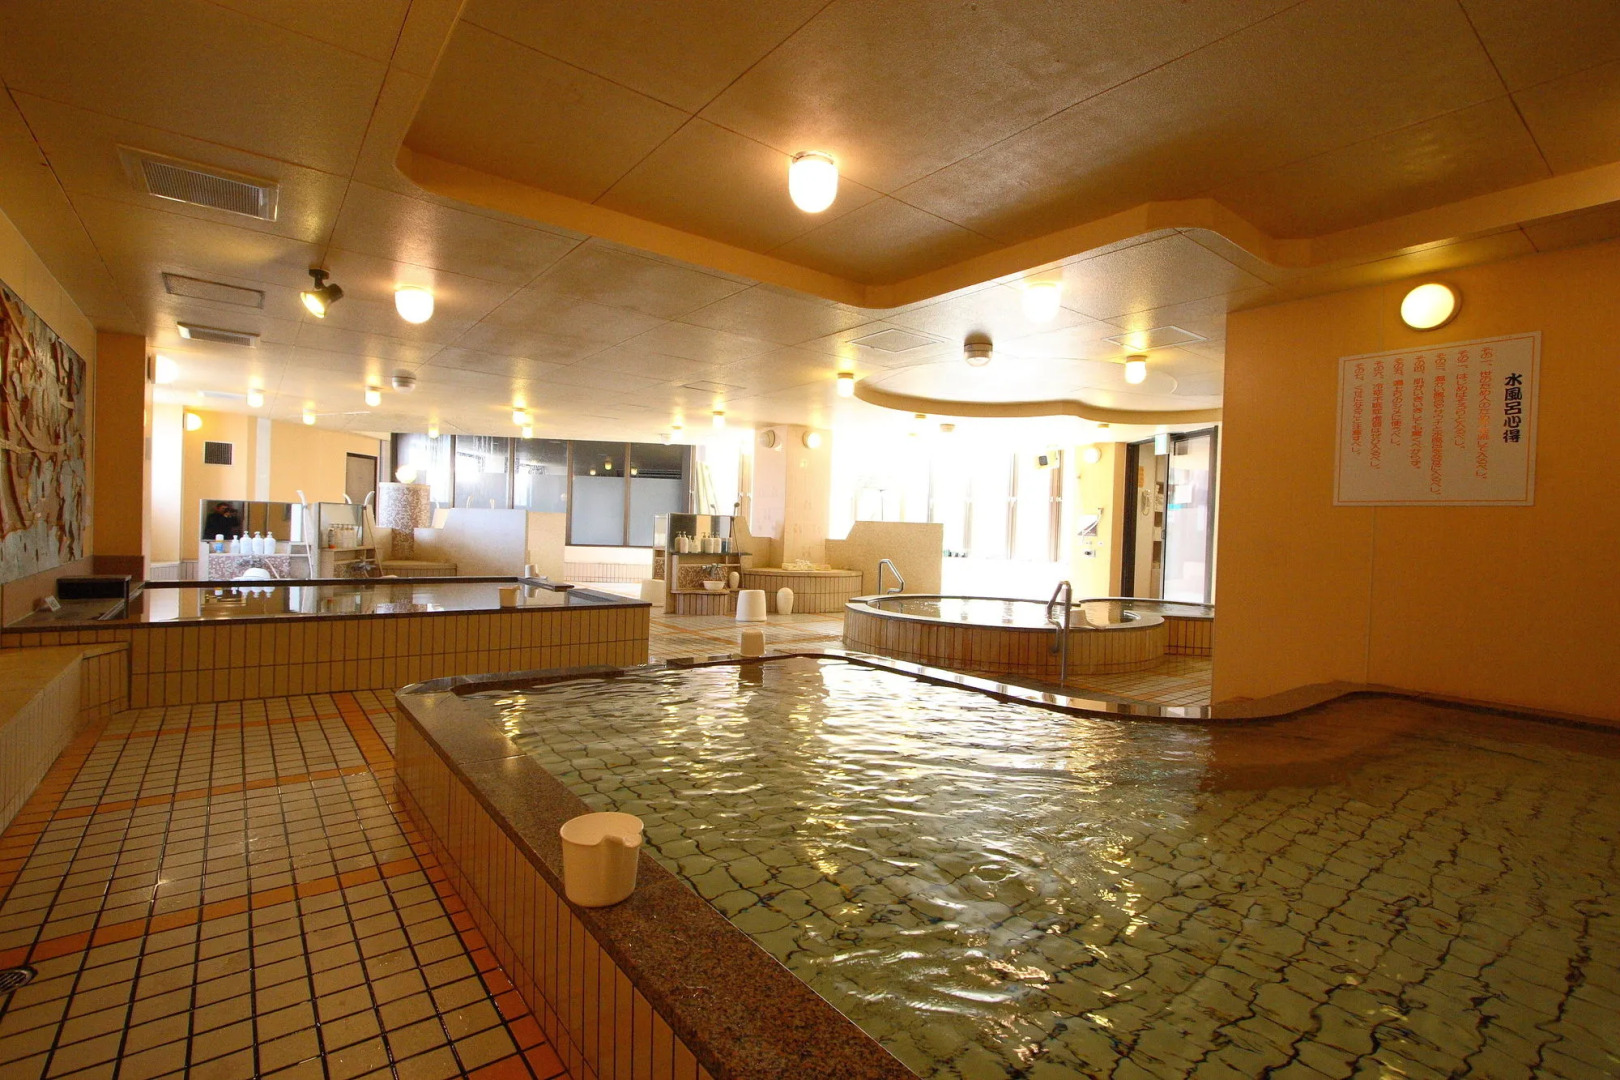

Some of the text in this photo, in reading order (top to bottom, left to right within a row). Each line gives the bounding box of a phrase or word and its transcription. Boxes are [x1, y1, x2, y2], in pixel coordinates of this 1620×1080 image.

[1502, 372, 1522, 443] 水風呂心得
